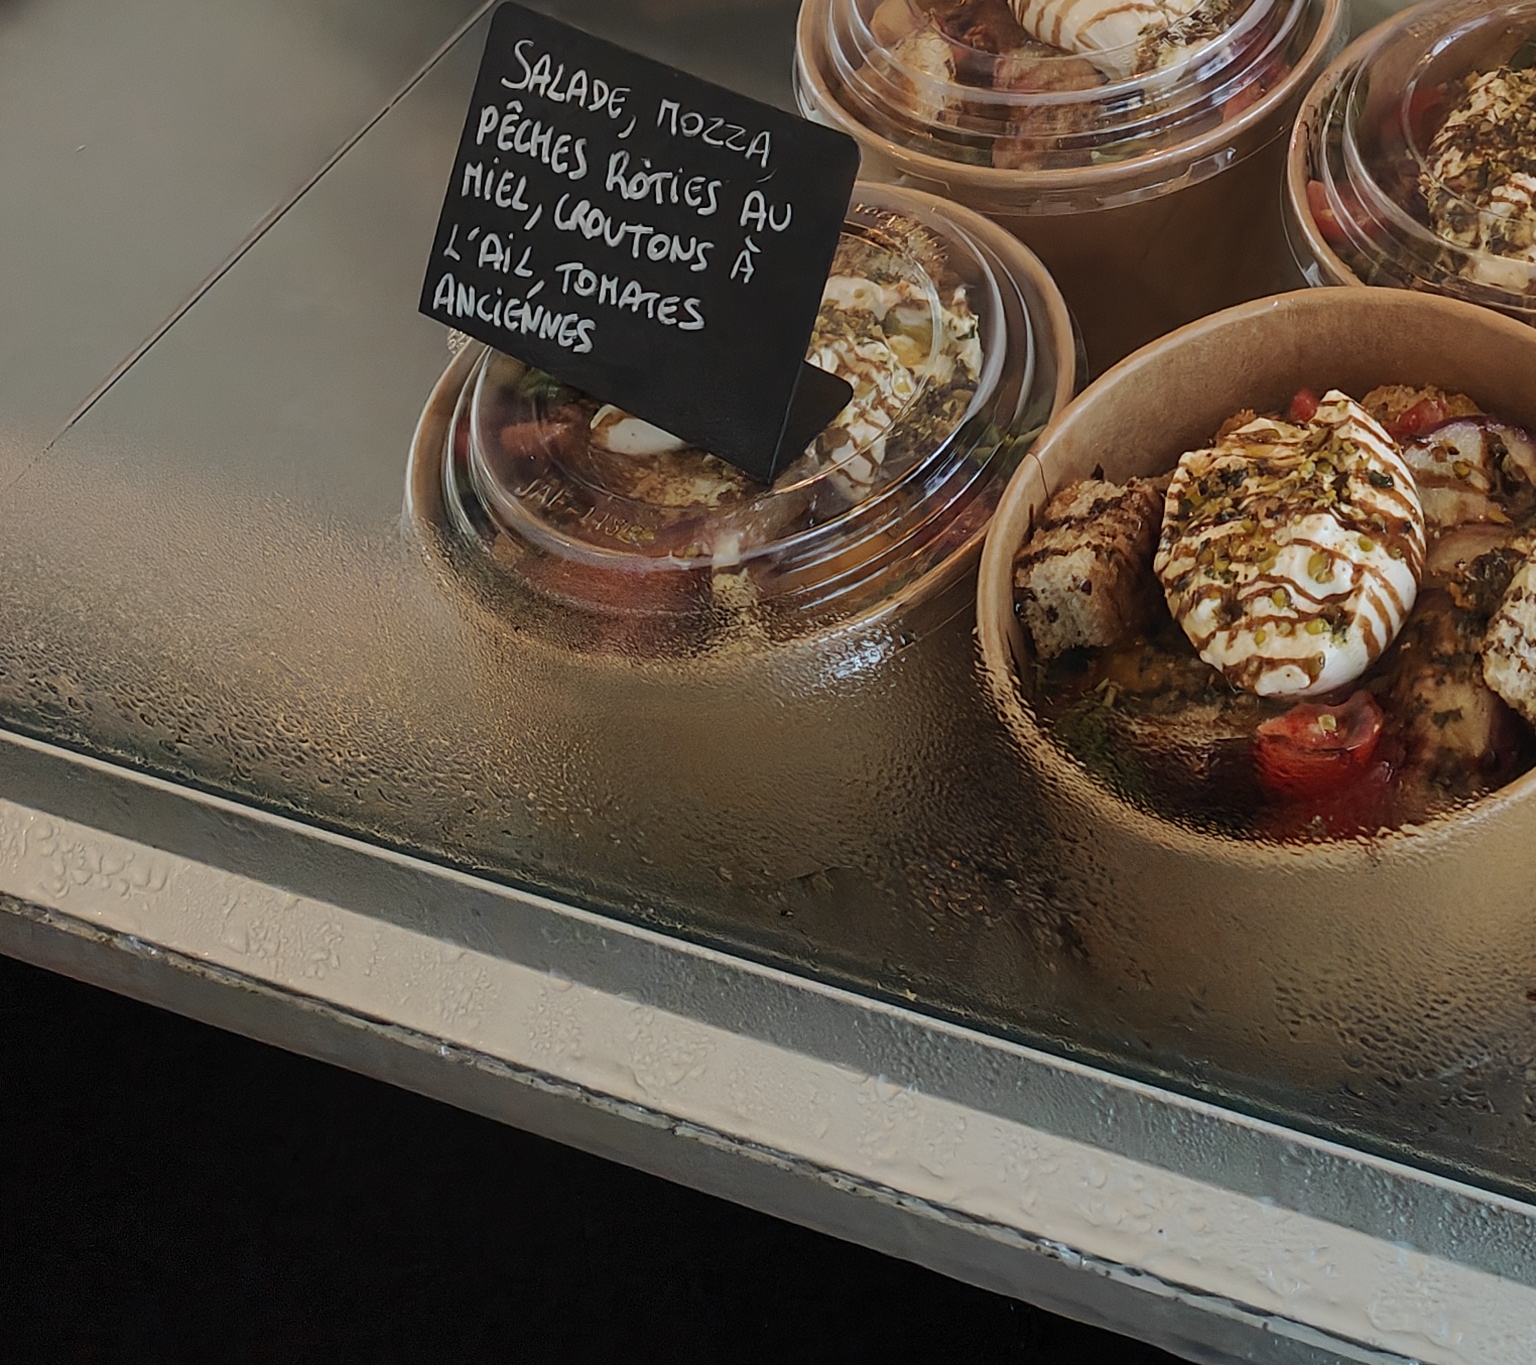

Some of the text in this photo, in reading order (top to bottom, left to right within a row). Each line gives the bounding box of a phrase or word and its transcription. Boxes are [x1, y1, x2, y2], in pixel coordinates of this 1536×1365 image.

[501, 38, 638, 139] SALADE,
[475, 100, 589, 181] PÊCHES
[738, 190, 793, 233] AU
[553, 192, 715, 272] CROUTONS
[555, 260, 706, 332] TOMATES
